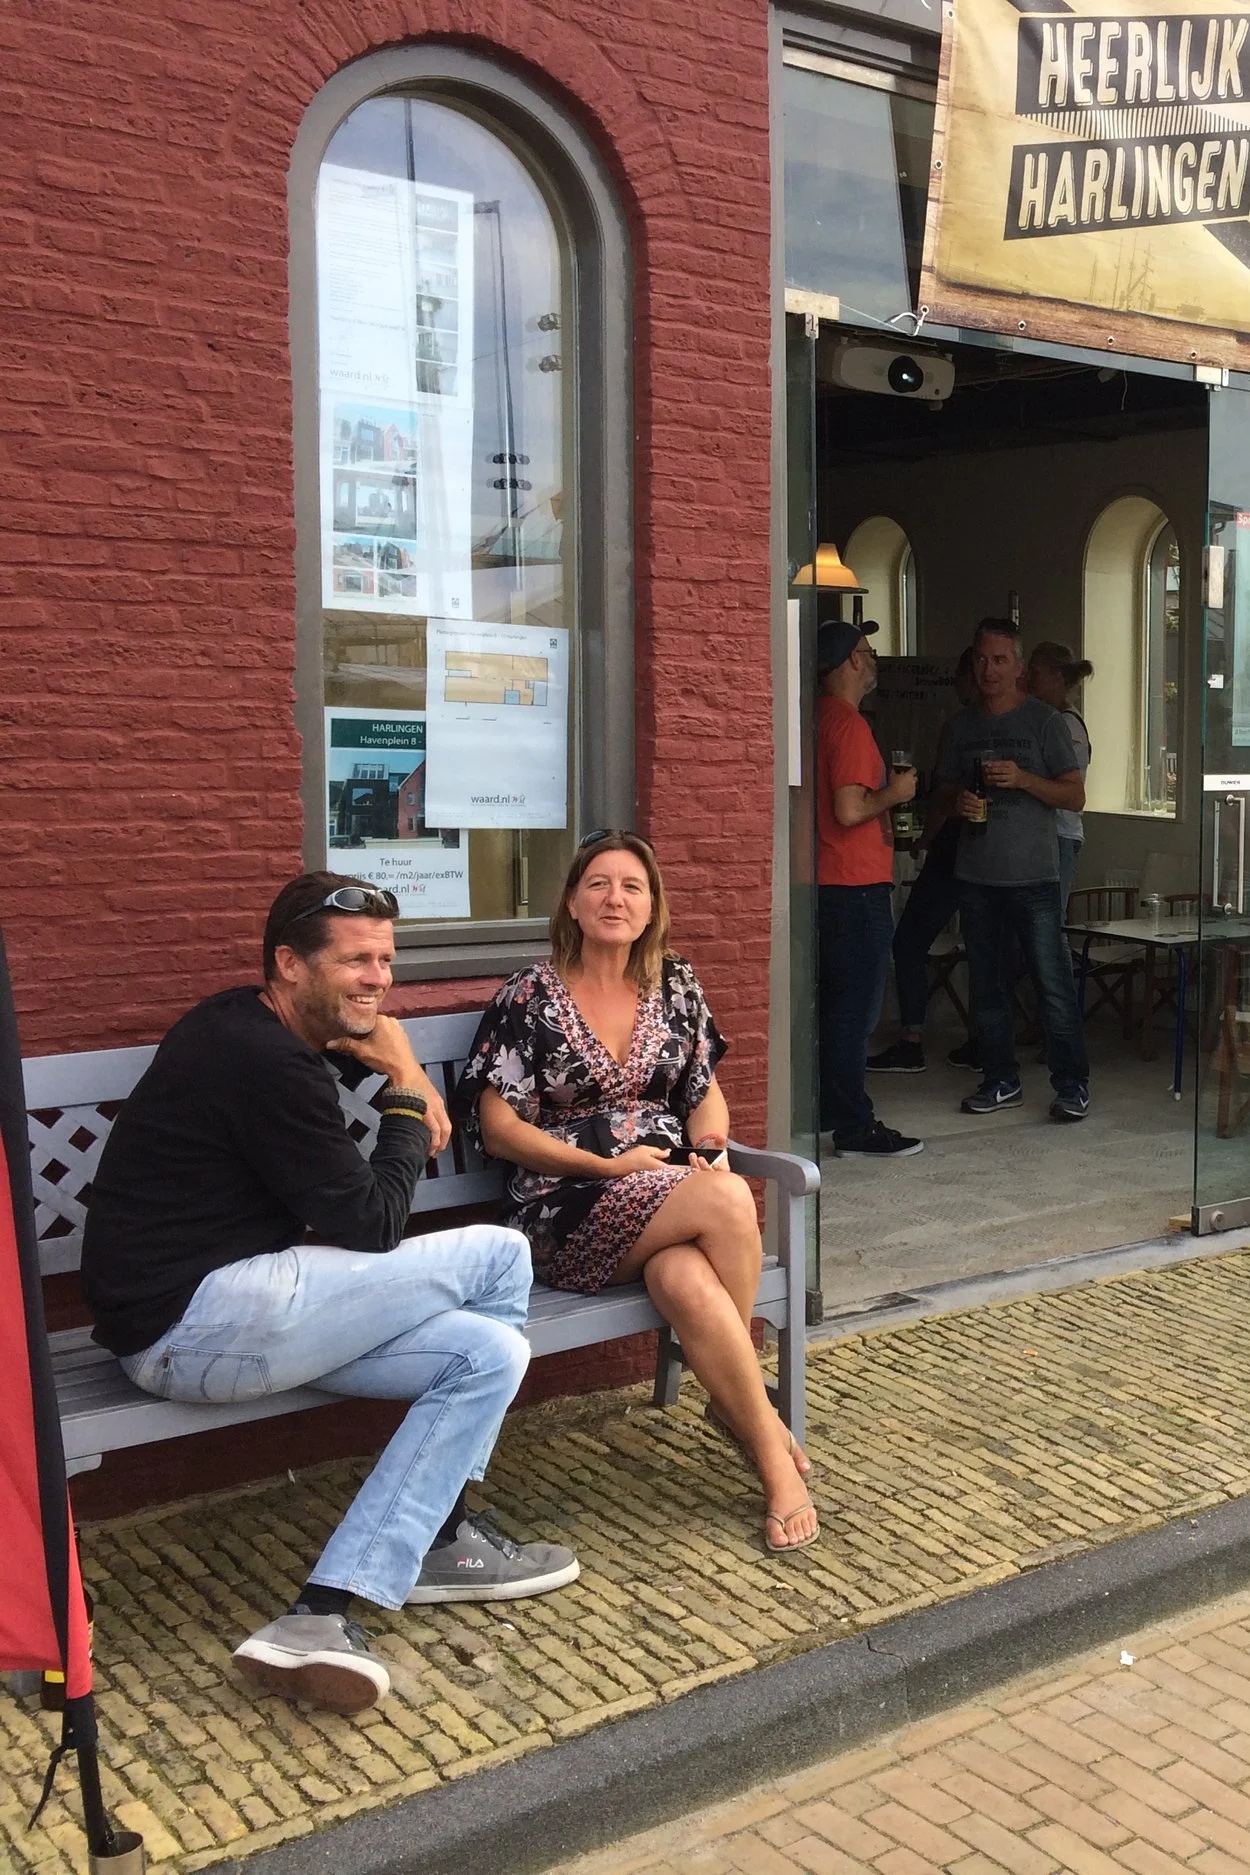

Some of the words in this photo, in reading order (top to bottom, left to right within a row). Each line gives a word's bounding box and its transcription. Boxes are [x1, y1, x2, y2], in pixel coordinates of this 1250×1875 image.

[1037, 18, 1250, 108] HEERLIJK
[1020, 137, 1249, 232] HARLINGEN
[372, 723, 424, 735] HARLINGEN
[360, 736, 409, 747] Havenplein
[471, 795, 510, 804] waard.nl
[380, 858, 391, 867] Te
[392, 858, 413, 867] huur
[456, 1555, 485, 1568] FILA
